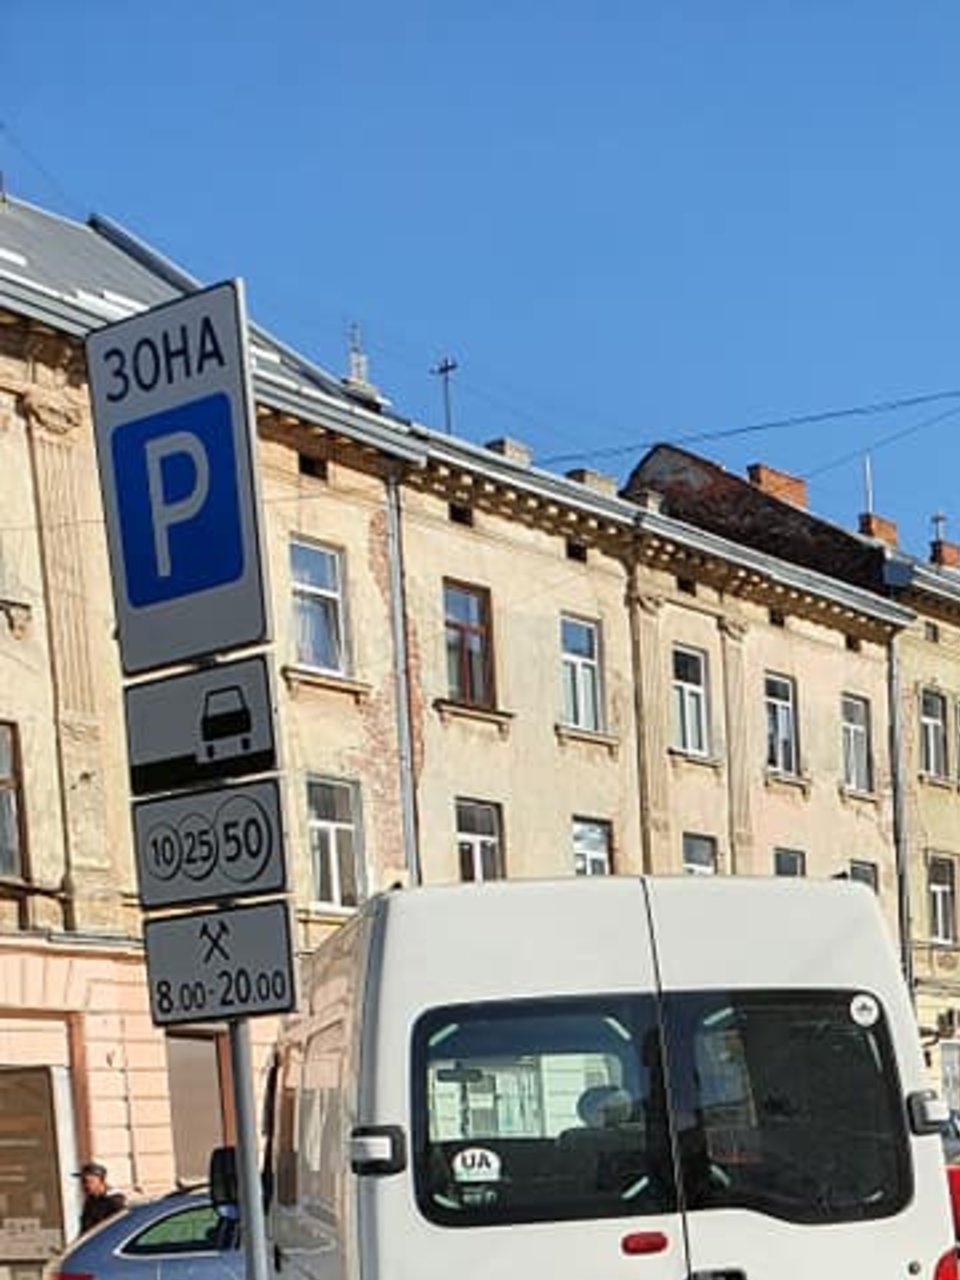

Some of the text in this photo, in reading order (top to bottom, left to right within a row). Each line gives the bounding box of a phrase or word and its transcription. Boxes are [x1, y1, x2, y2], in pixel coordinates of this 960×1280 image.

[103, 316, 225, 402] ЗОНА
[145, 431, 210, 577] P
[151, 817, 263, 868] 10 25 50
[461, 1152, 491, 1169] UA
